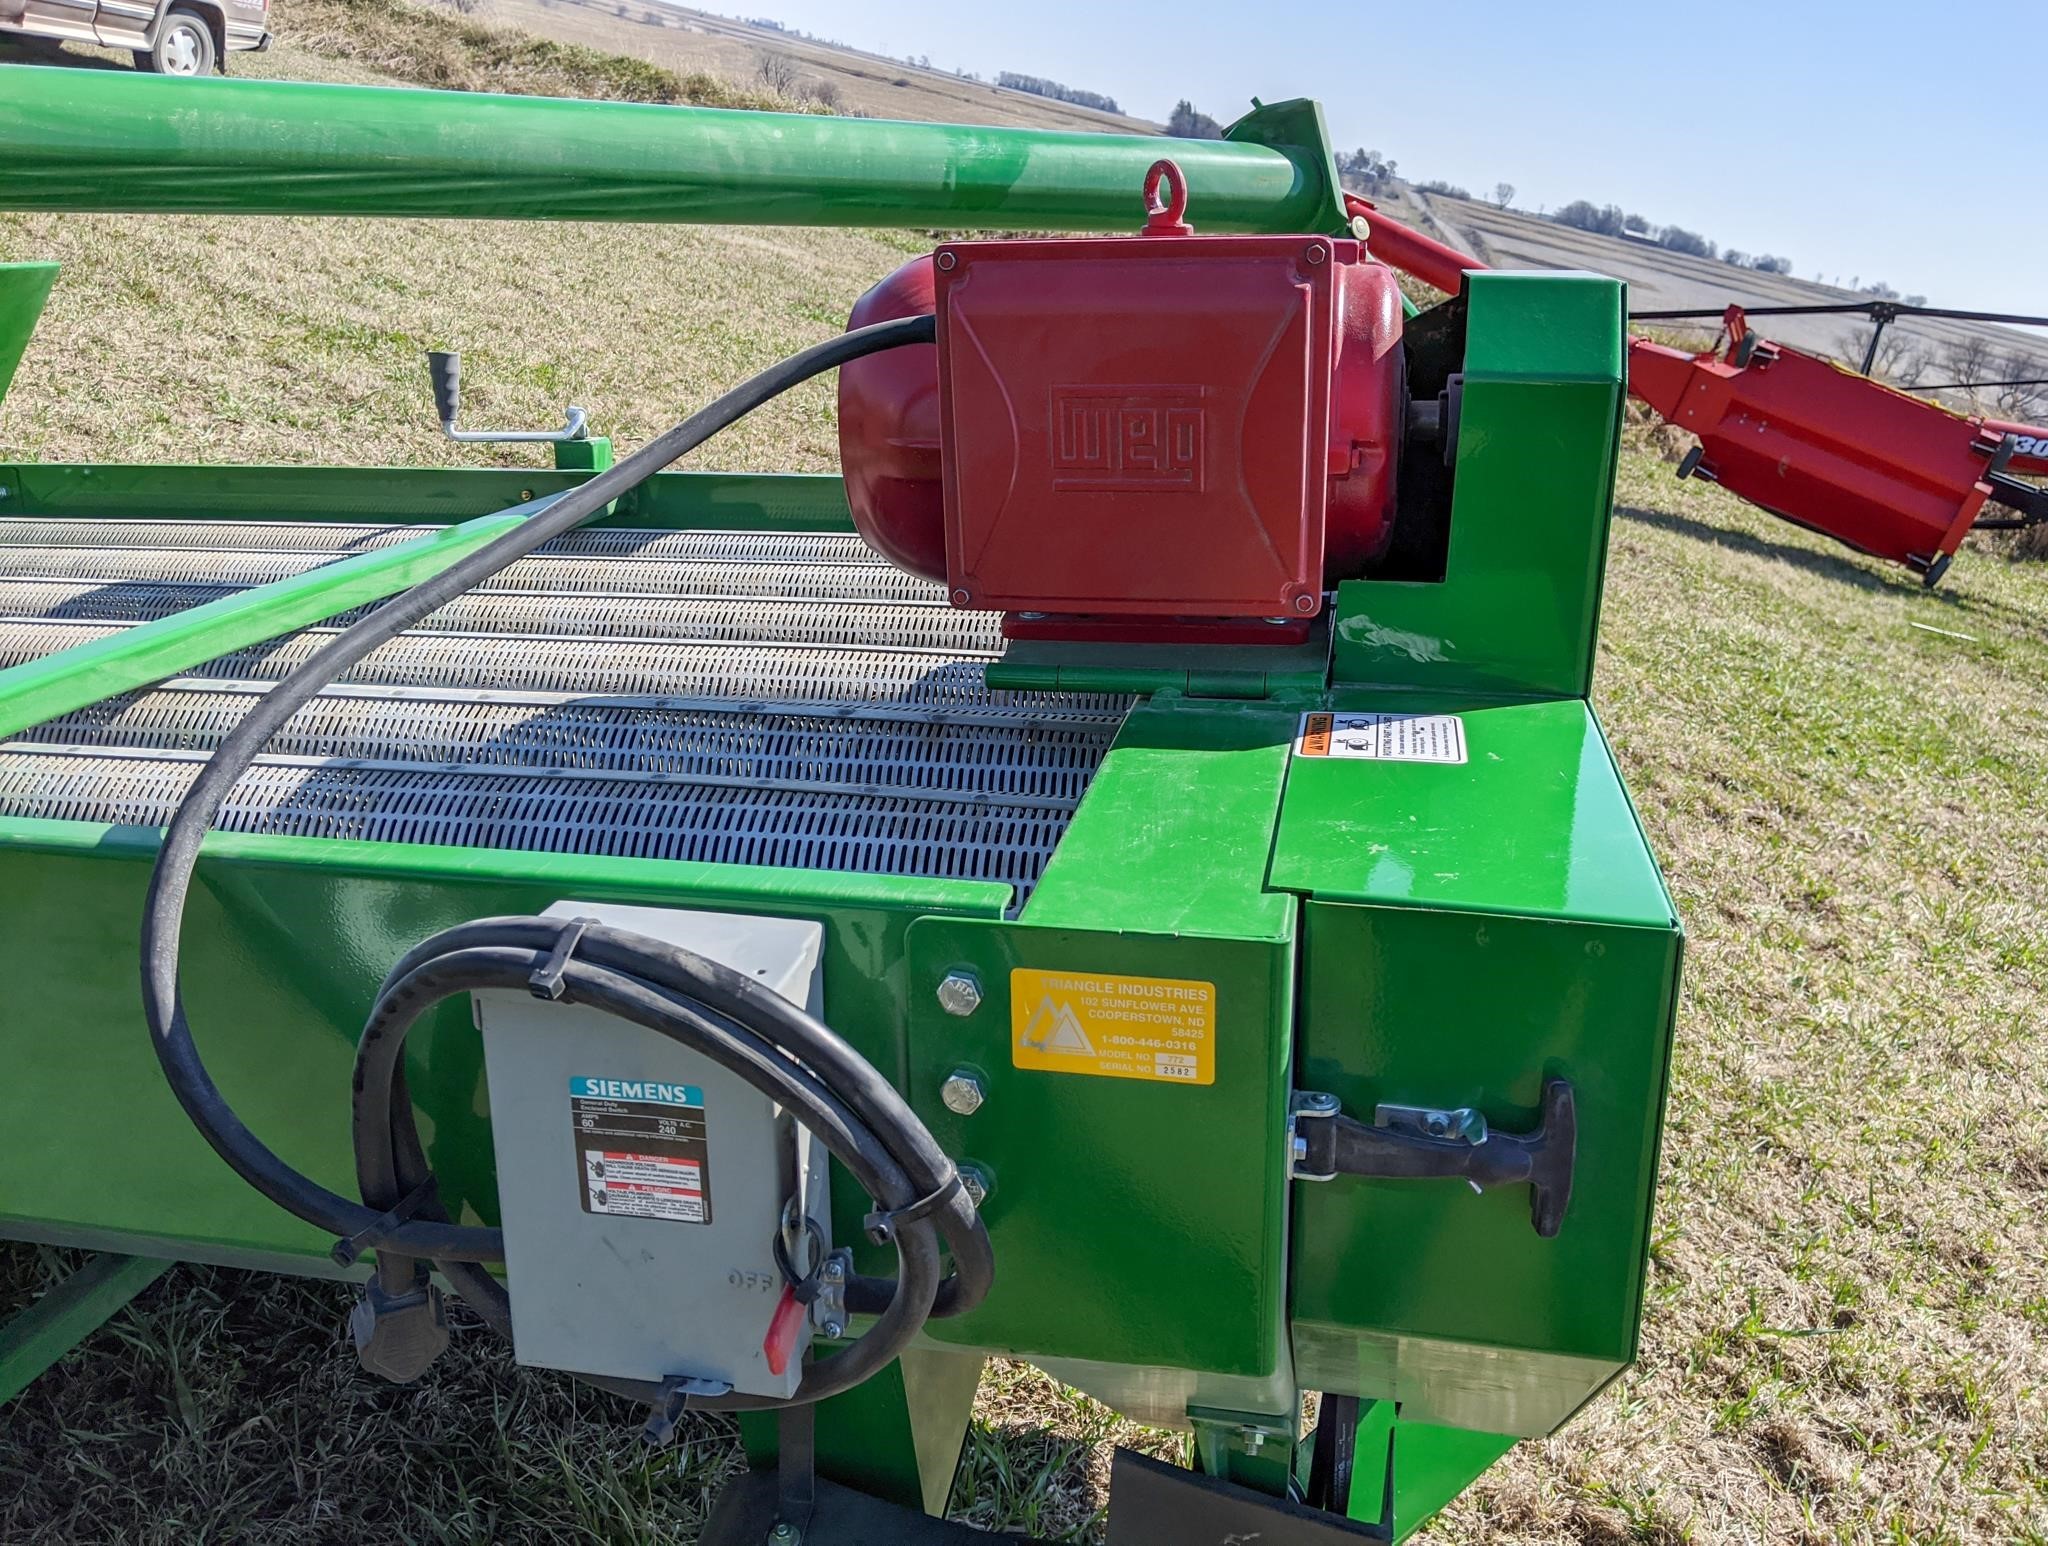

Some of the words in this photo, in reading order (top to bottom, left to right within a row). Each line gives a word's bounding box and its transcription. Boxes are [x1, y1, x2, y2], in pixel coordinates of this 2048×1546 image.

[1309, 717, 1328, 745] WARNING
[1041, 977, 1114, 994] TRIANGLE
[1118, 984, 1209, 1001] INDUSTRIES
[1081, 996, 1098, 1006] 102
[1102, 998, 1176, 1012] SUNFLOWER
[1188, 1017, 1206, 1027] ND
[1172, 1027, 1204, 1039] 58425
[1102, 1035, 1197, 1051] 1-800-446-0316
[1099, 1049, 1133, 1061] MODEL
[1100, 1061, 1134, 1072] SERIAL
[1163, 1066, 1190, 1076] 2582
[586, 1079, 687, 1103] SIEMENS
[580, 1099, 603, 1107] General
[581, 1119, 594, 1128] 60
[658, 1119, 678, 1127] VOLTS
[658, 1125, 677, 1135] 240
[639, 1155, 669, 1163] DANGER
[728, 1267, 774, 1293] OFF
